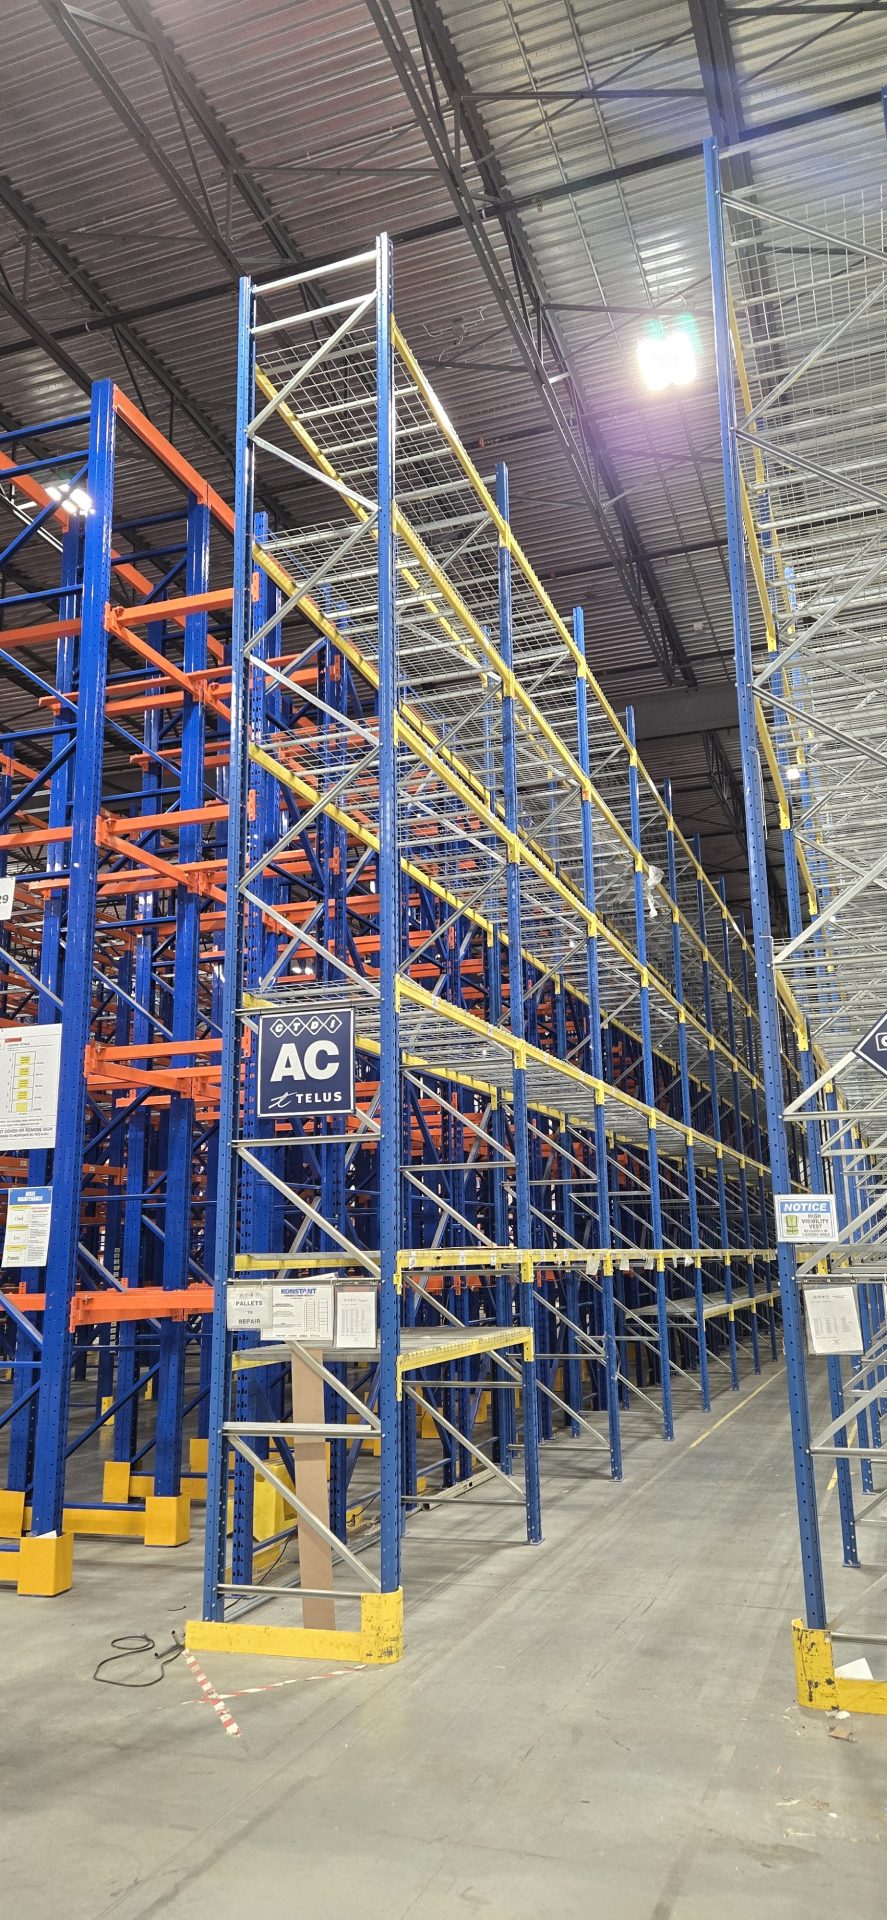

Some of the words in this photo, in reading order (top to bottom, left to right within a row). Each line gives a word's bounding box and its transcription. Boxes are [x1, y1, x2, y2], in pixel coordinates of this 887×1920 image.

[0, 894, 9, 904] 9
[270, 1040, 340, 1082] AC
[296, 1092, 342, 1104] TELUS
[783, 1202, 828, 1212] NOTICE
